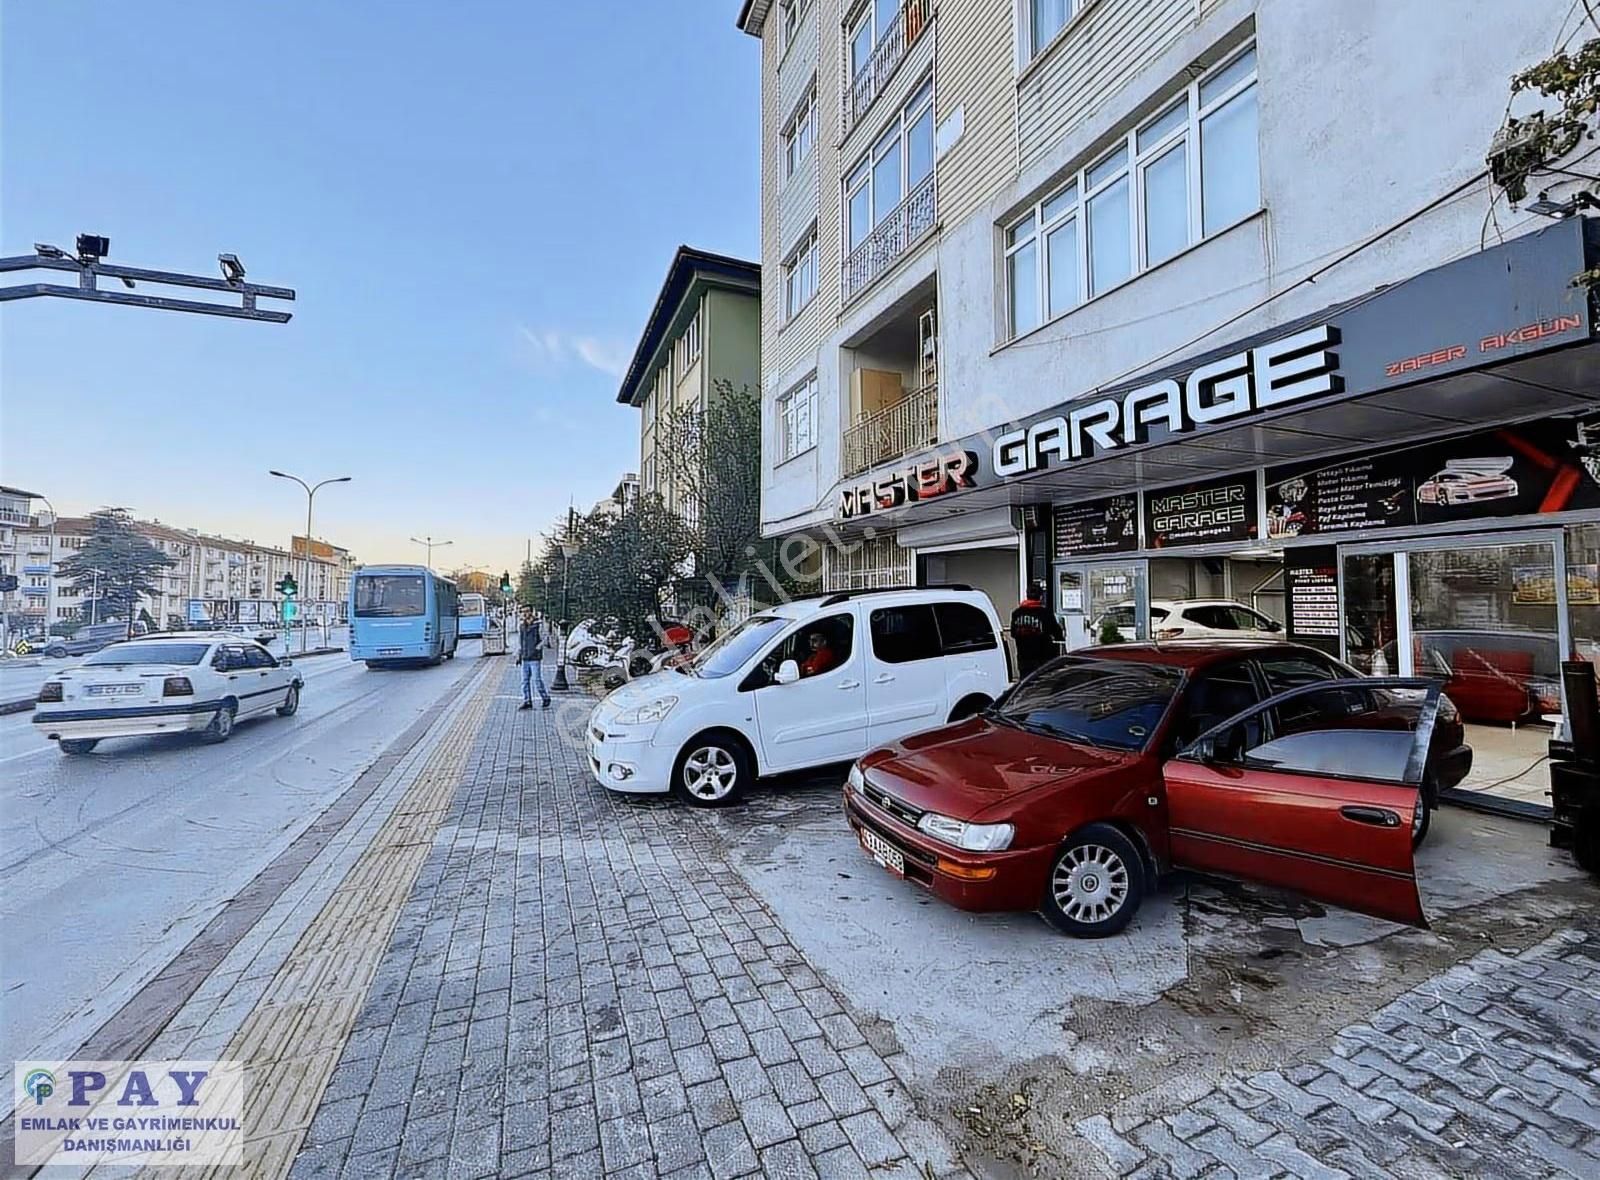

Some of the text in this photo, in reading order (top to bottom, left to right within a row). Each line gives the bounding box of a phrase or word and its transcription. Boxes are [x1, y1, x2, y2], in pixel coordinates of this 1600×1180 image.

[1385, 345, 1467, 377] ZAFER
[840, 324, 1344, 518] MASTER GARAGE
[1152, 485, 1245, 513] MASTER
[1154, 504, 1245, 532] GARAGE
